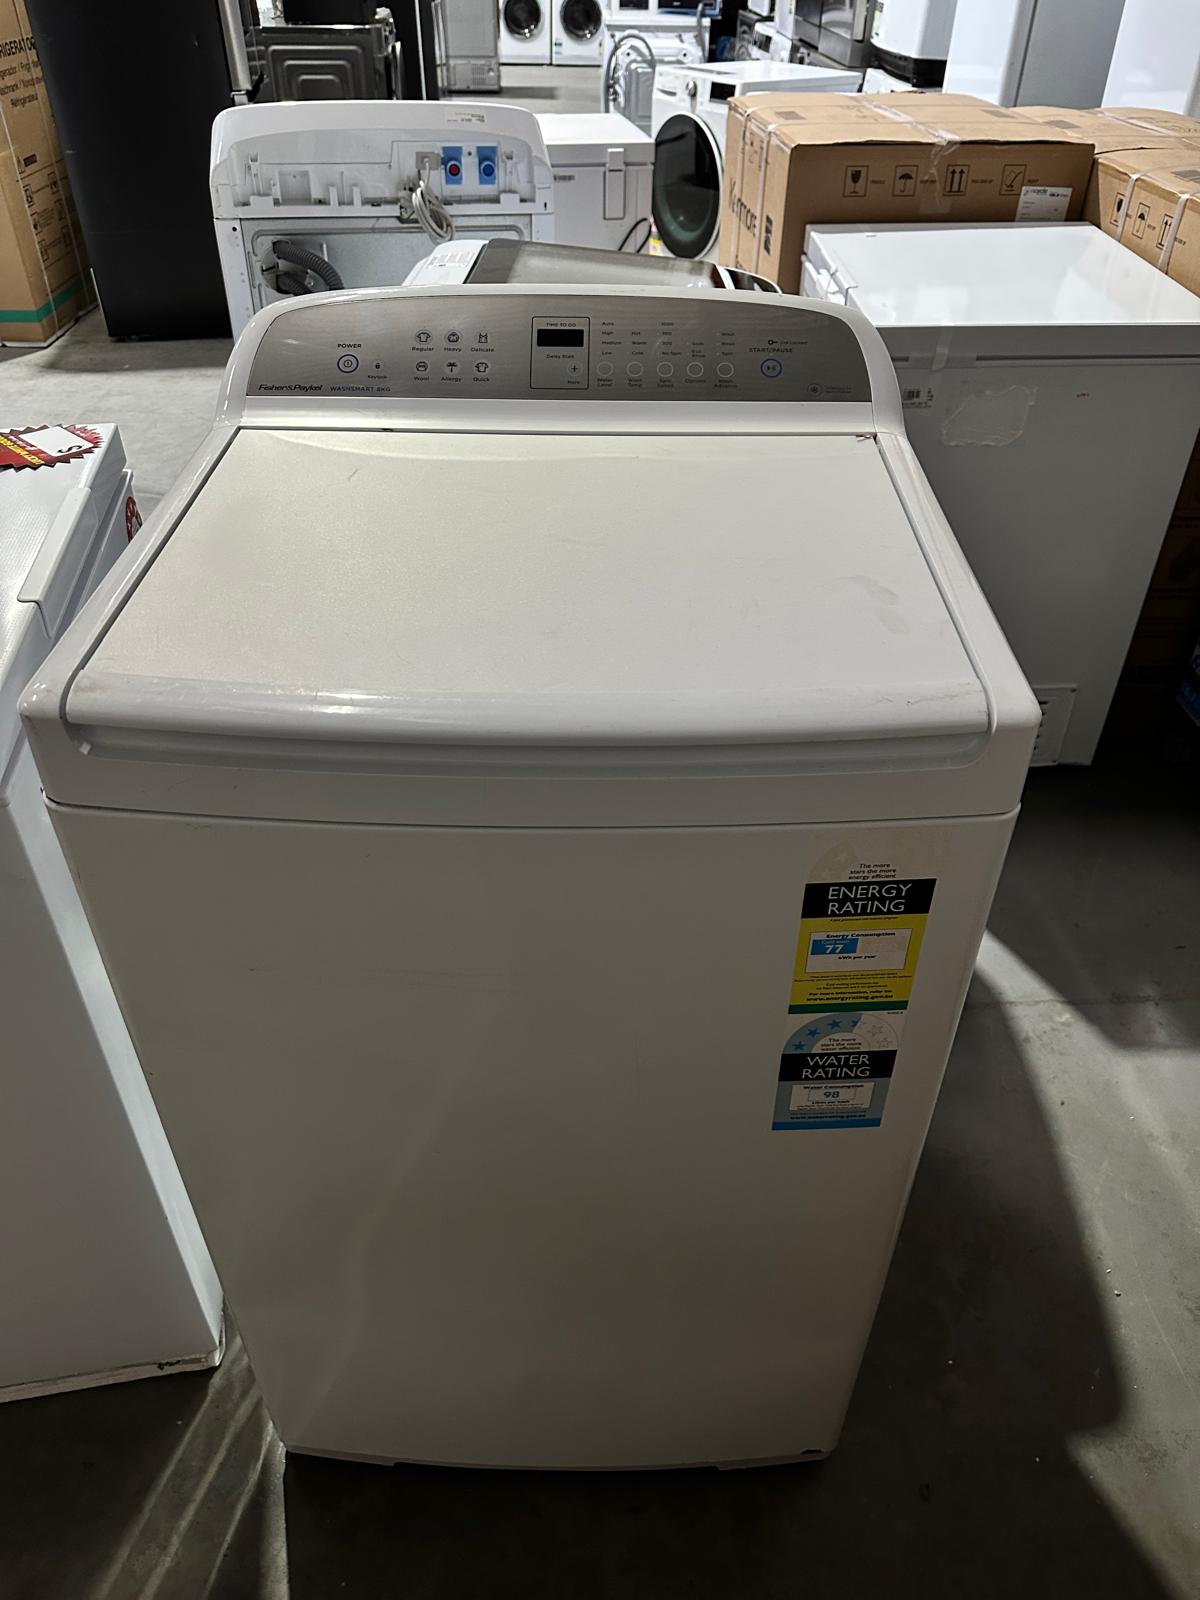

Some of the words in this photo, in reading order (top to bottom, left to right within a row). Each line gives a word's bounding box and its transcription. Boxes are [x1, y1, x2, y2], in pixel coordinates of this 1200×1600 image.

[258, 384, 323, 393] Fisher&Paykel
[828, 883, 913, 900] ENERGY
[827, 899, 906, 915] RATING
[825, 945, 844, 954] 77
[806, 994, 893, 1002] www.energyrating.gov.au
[807, 1054, 870, 1066] WATER
[802, 1066, 871, 1079] RATING
[823, 1091, 840, 1099] 98
